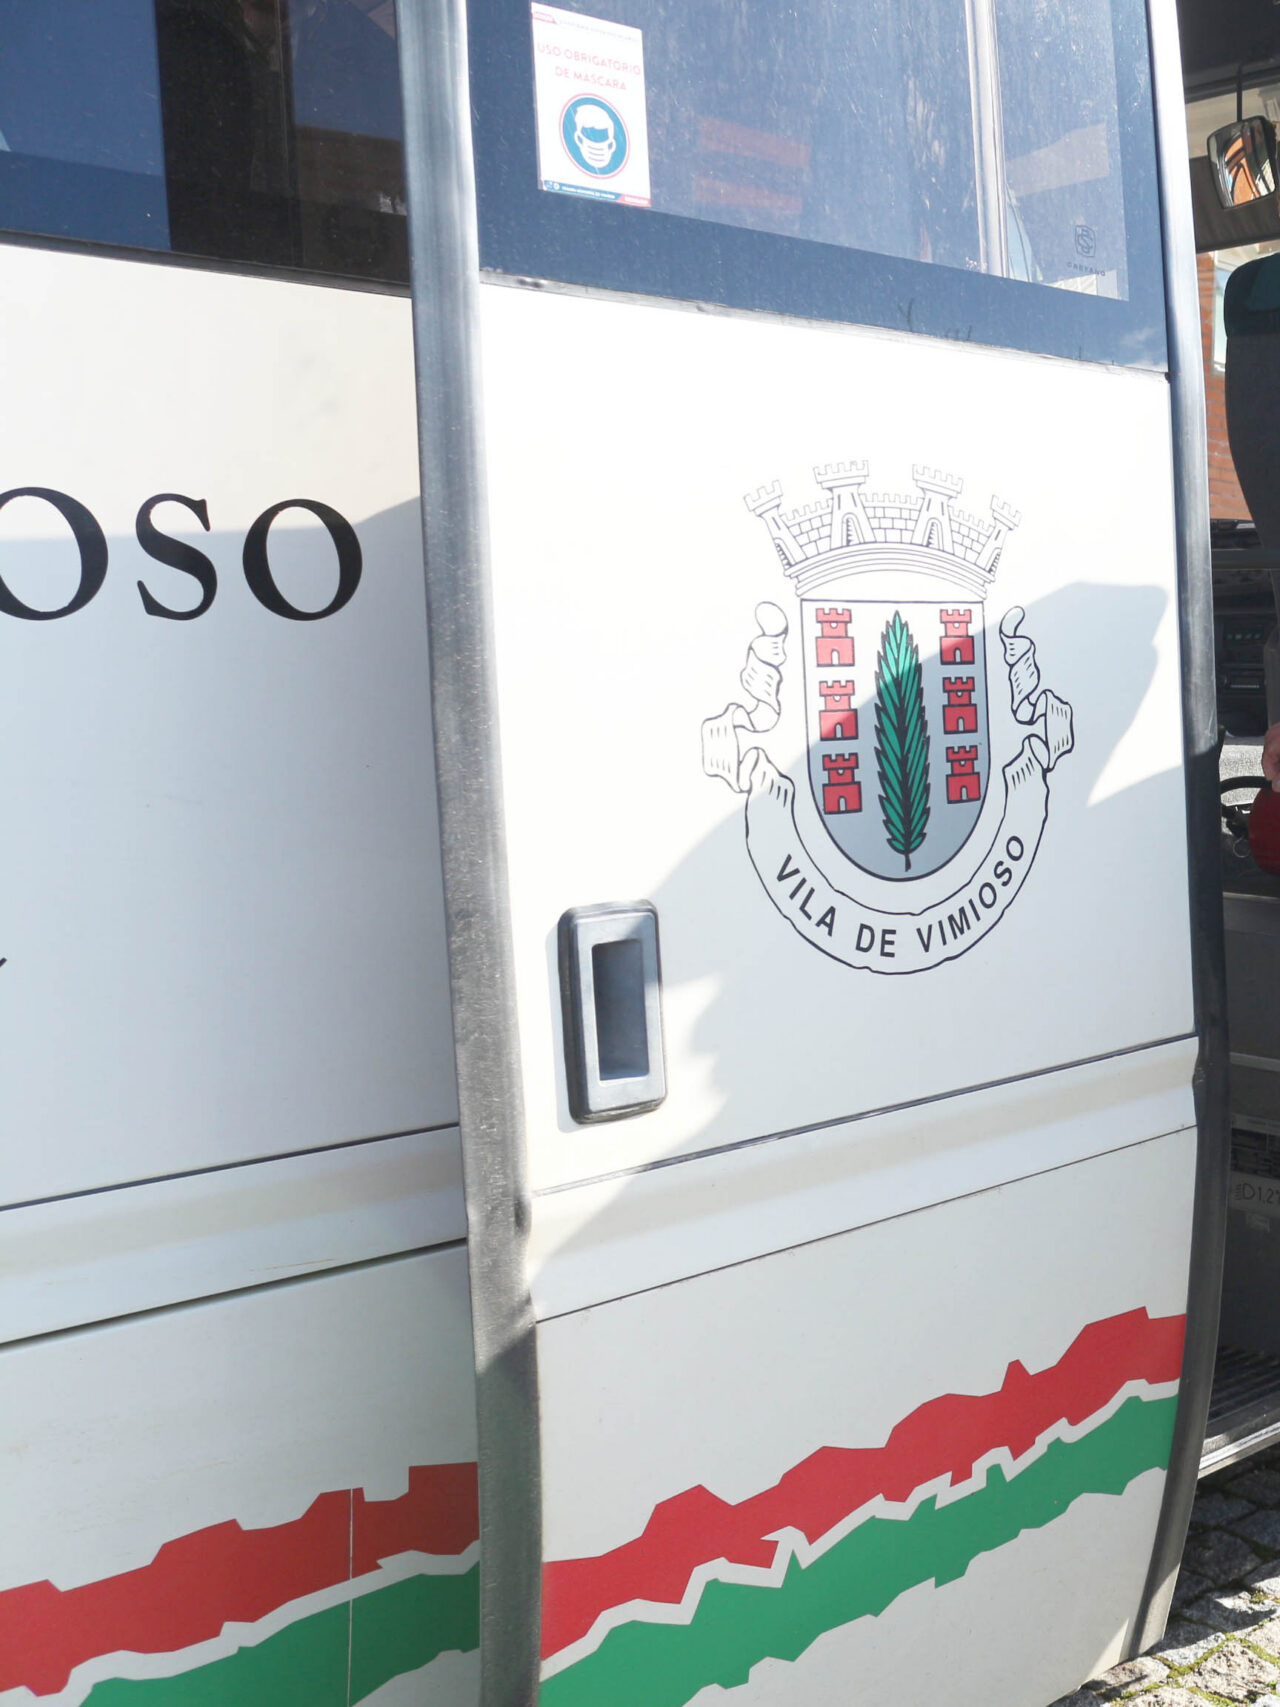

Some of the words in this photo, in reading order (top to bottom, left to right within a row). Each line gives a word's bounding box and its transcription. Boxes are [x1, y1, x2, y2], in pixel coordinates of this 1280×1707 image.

[555, 66, 569, 79] DE
[0, 486, 363, 621] OSO
[775, 854, 836, 937] VILA
[855, 922, 897, 958] DE
[916, 835, 1025, 953] VIMIOSO
